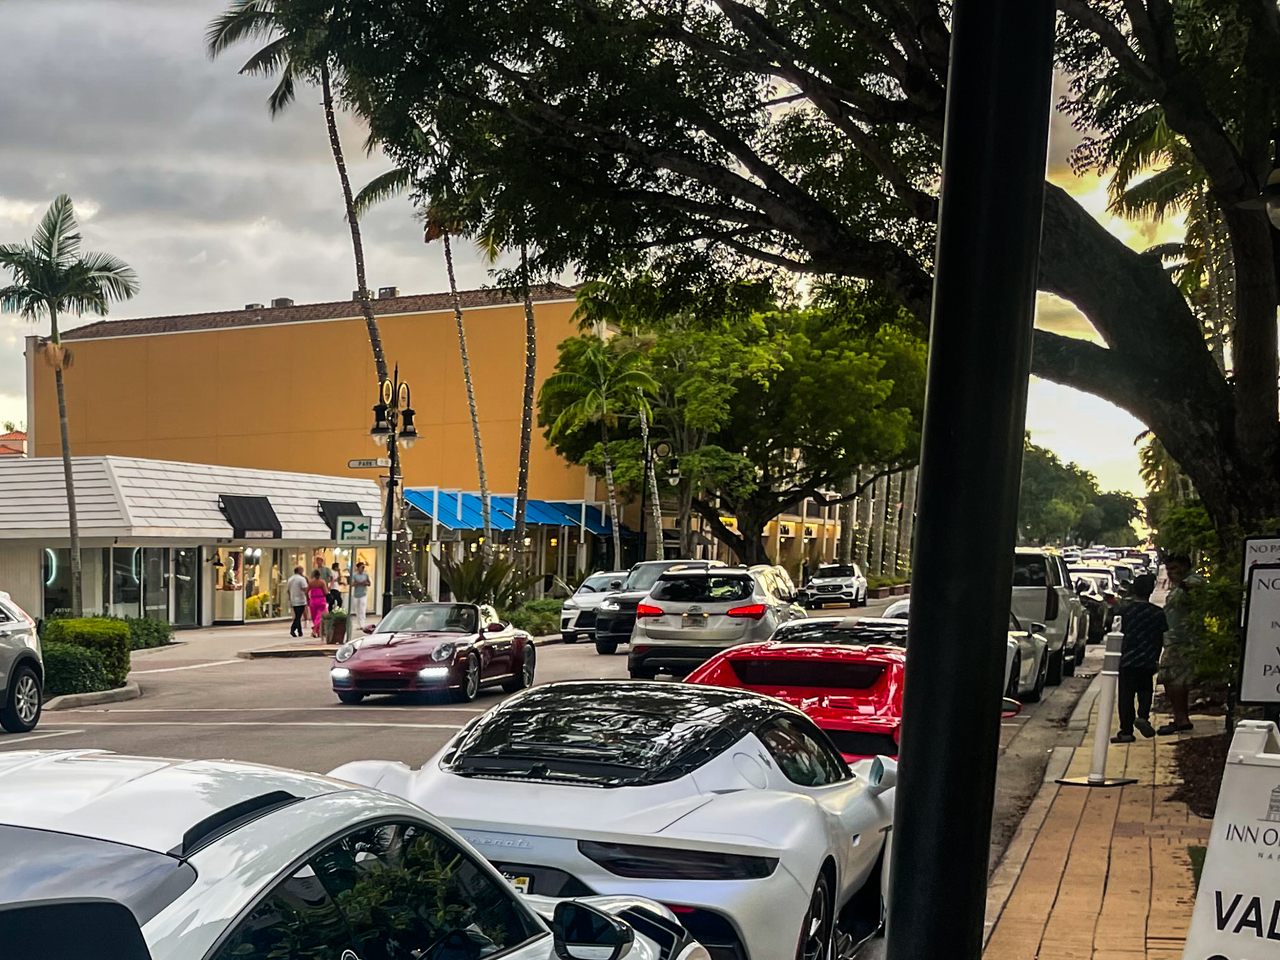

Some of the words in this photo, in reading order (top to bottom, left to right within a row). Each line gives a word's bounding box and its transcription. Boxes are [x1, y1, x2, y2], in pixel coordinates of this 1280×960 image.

[1250, 545, 1268, 553] NO
[1226, 823, 1259, 844] INN
[1263, 828, 1280, 847] O
